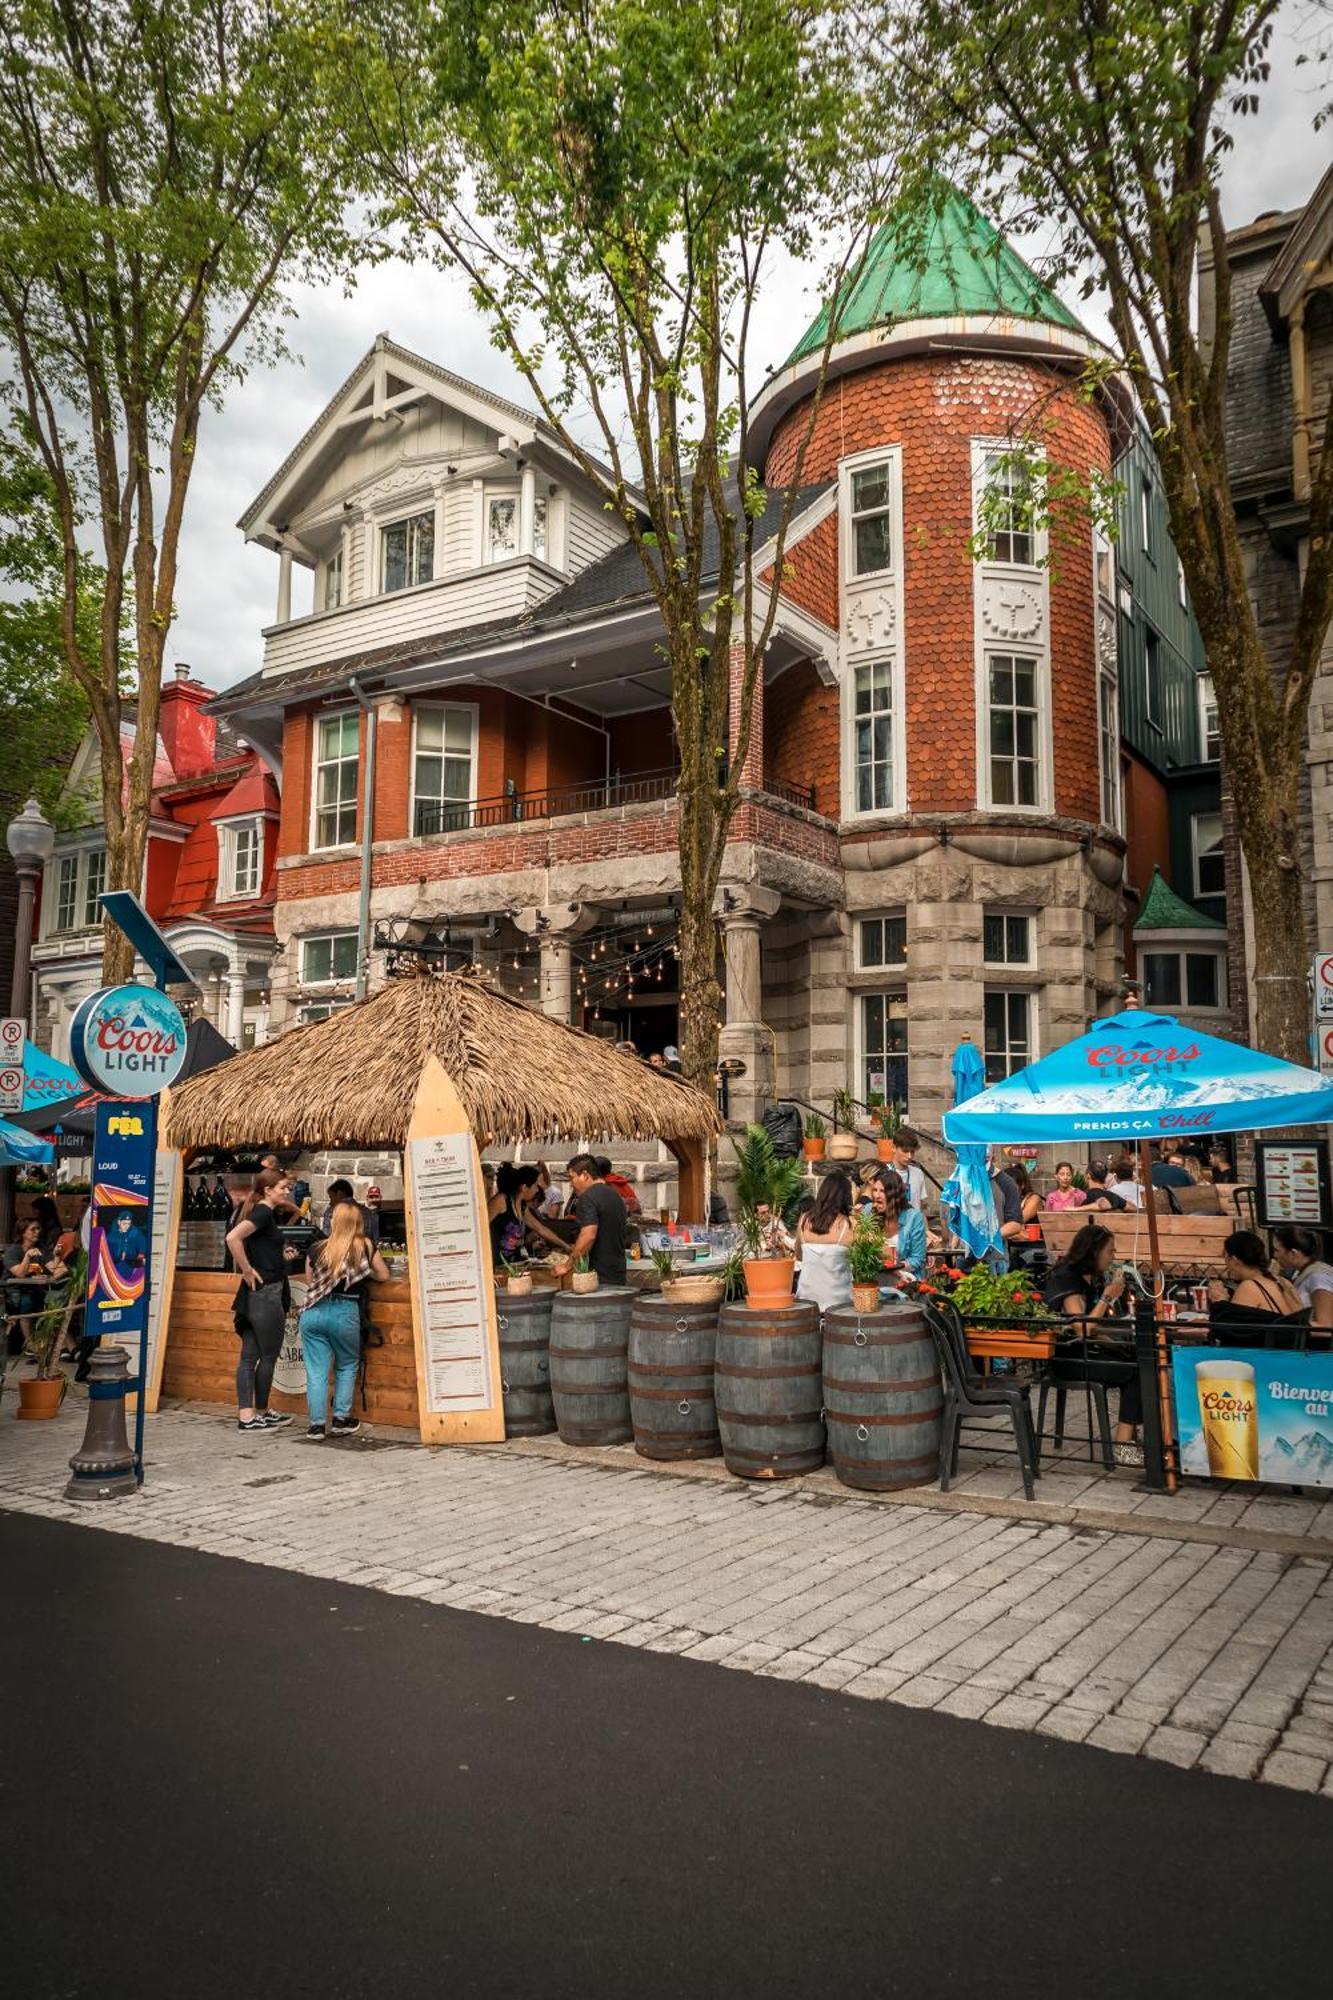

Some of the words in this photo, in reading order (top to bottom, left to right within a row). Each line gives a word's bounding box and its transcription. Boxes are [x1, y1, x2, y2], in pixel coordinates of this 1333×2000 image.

[97, 1016, 177, 1054] Coors
[105, 1052, 169, 1072] LIGHT
[1085, 1043, 1201, 1067] Coors
[1100, 1060, 1192, 1078] LIGHT
[1073, 1121, 1130, 1131] PRENDS
[1132, 1120, 1152, 1131] ÇA
[1158, 1110, 1216, 1129] Chill
[58, 1135, 85, 1147] LIGHT
[98, 1162, 118, 1170] LOUD
[1202, 1392, 1254, 1412] Coors
[1305, 1402, 1328, 1416] au
[1209, 1411, 1249, 1422] LIGHT
